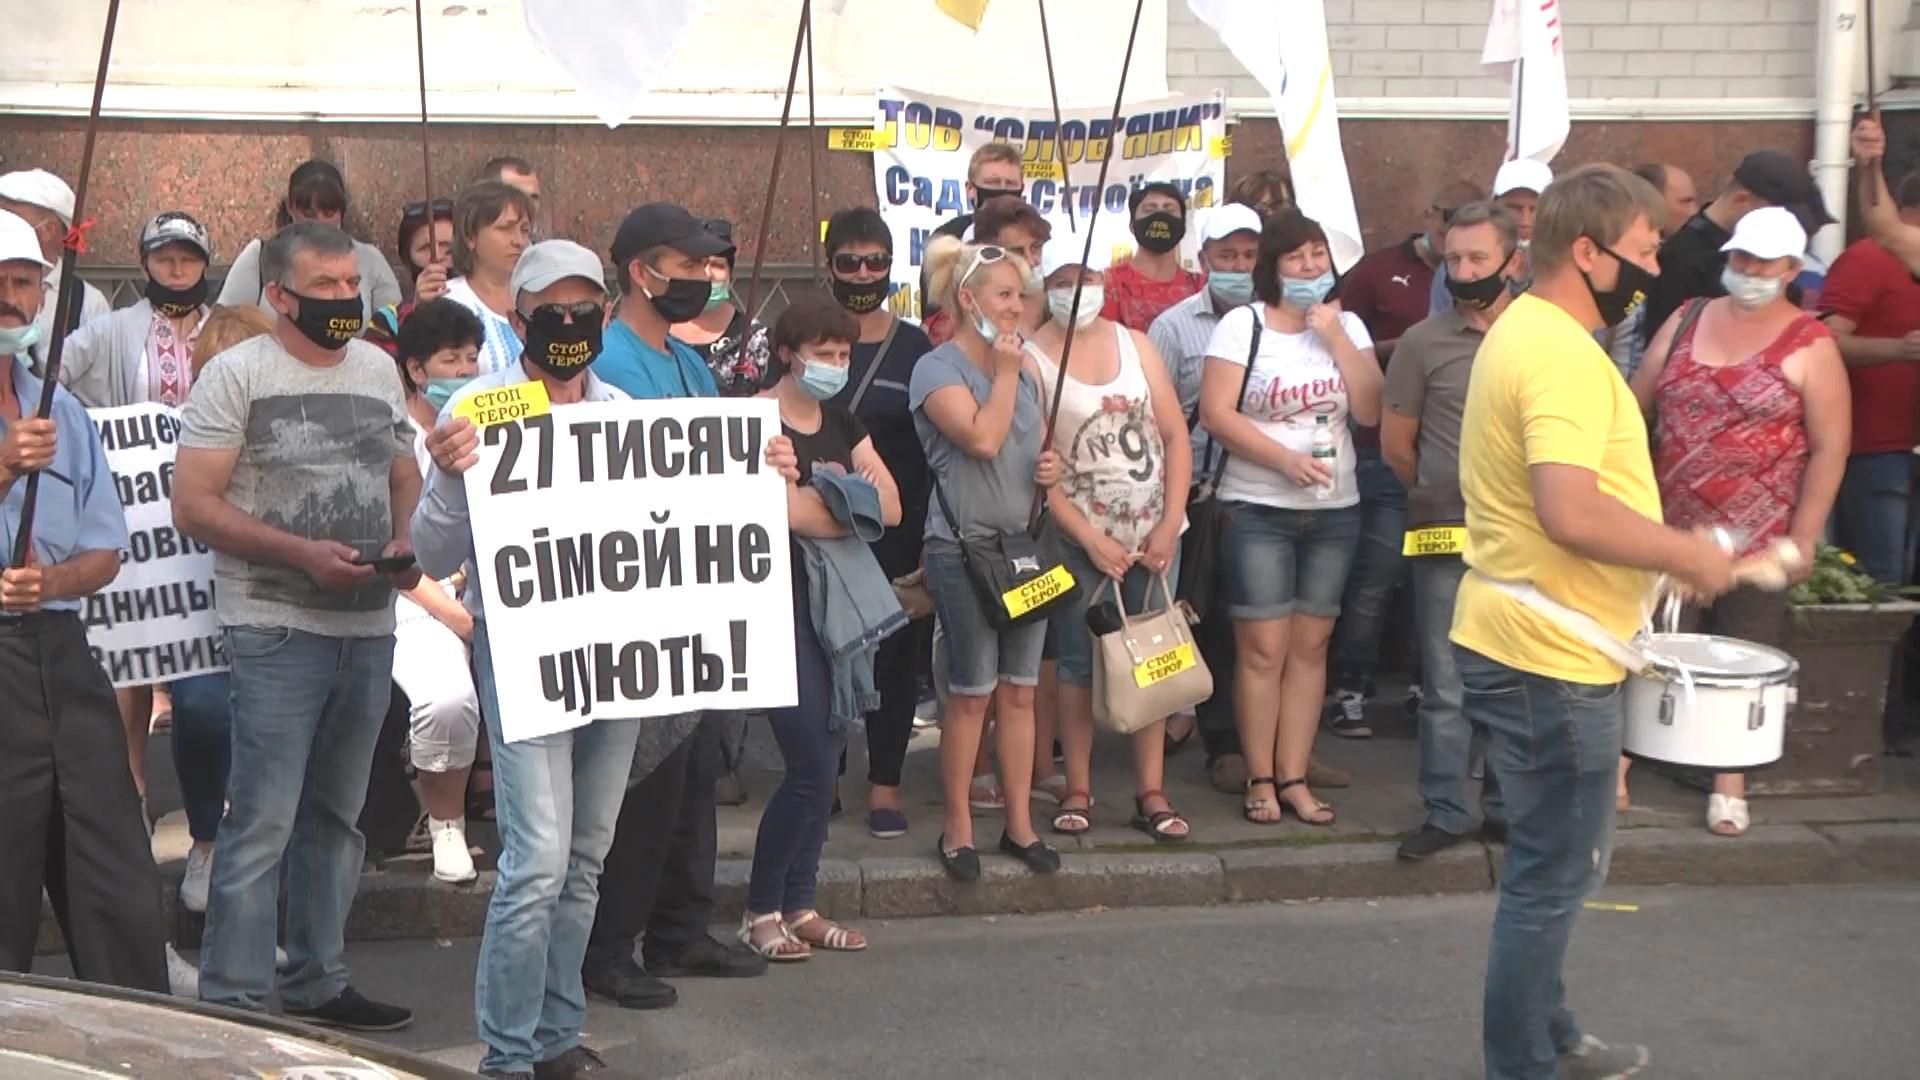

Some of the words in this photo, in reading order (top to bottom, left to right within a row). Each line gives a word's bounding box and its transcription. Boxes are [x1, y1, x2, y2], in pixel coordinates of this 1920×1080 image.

[843, 131, 872, 140] СТОП
[879, 99, 963, 152] ТОВ
[841, 140, 876, 149] ТЕРОР
[1022, 171, 1056, 179] ЕРОР
[329, 318, 361, 331] СТОП
[549, 340, 589, 354] СТОП
[546, 351, 593, 367] ТЕРОР
[474, 388, 522, 408] СТОП
[475, 403, 530, 424] ТЕРОР
[484, 413, 554, 496] 27
[569, 416, 762, 482] тисяч
[1118, 420, 1154, 482] 9
[1417, 529, 1452, 542] СТОП
[1416, 541, 1456, 553] ТЕРОР
[494, 510, 683, 609] сімей
[695, 523, 772, 584] не
[1021, 574, 1055, 598] СТОП
[1022, 582, 1061, 609] ТЕРОР
[539, 619, 748, 717] чують!
[1146, 650, 1177, 670] СТОП
[1147, 659, 1182, 681] ТЕРОР
